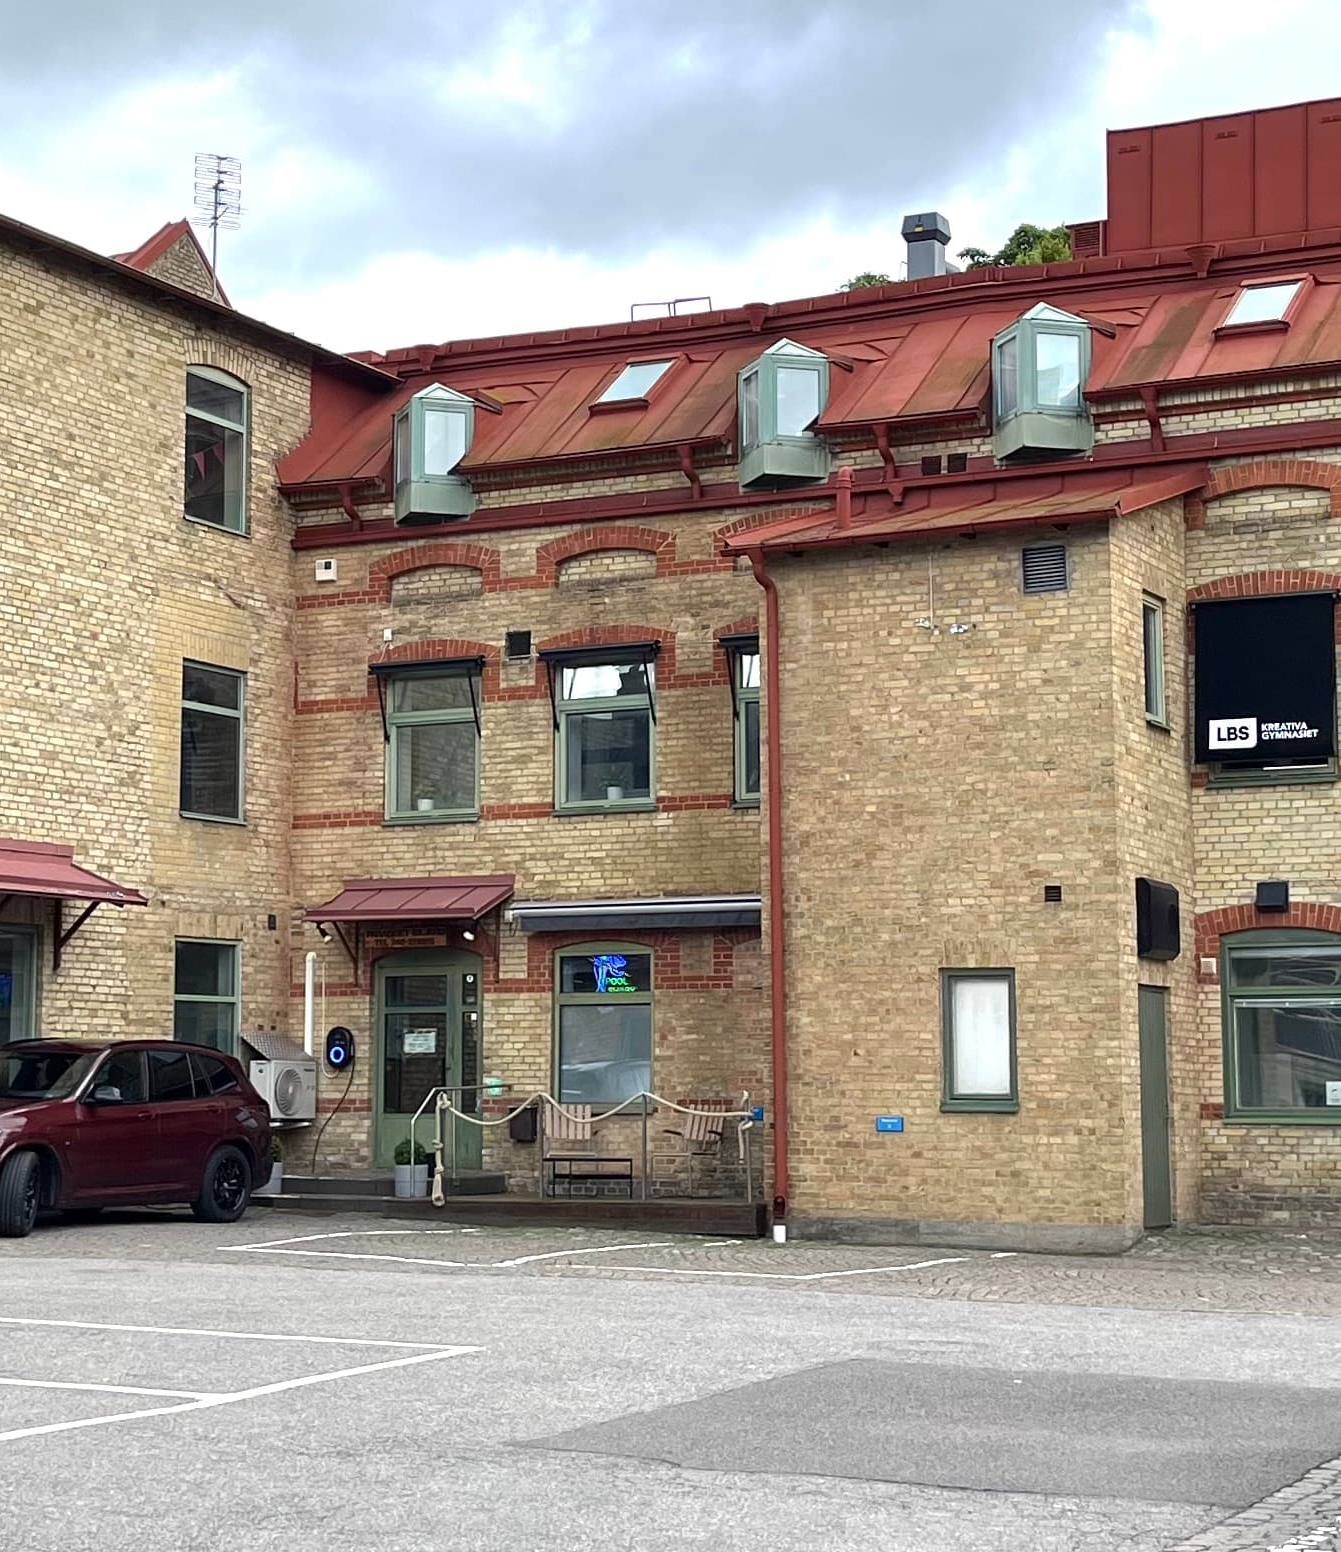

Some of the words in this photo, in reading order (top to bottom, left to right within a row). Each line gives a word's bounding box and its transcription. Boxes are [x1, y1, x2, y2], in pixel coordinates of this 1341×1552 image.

[1261, 721, 1308, 731] KREATIVA
[1216, 726, 1250, 742] LBS
[1261, 729, 1319, 740] GYMNASIET
